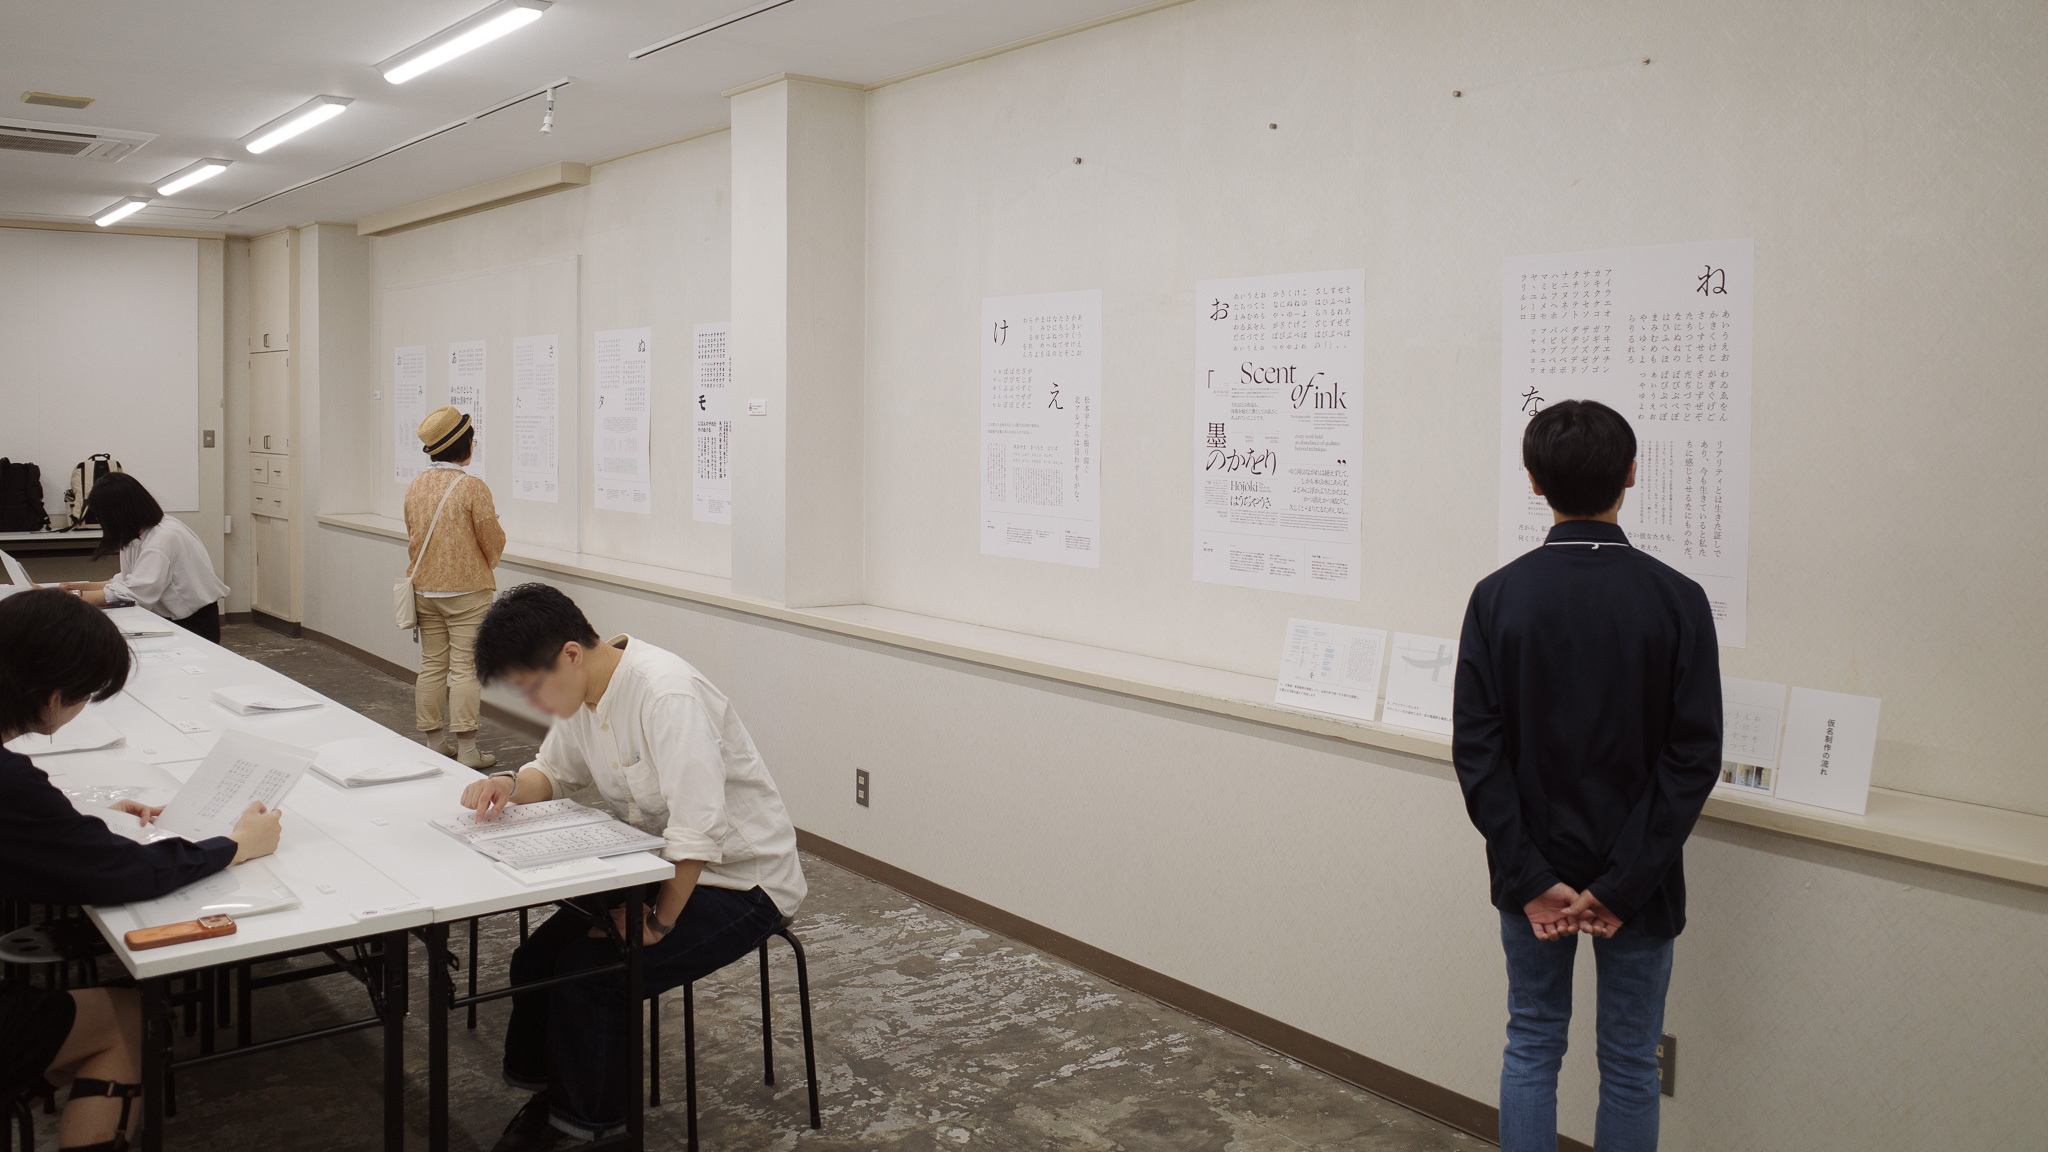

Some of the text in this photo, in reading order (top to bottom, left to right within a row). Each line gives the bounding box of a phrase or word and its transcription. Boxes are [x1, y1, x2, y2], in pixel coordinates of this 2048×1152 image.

[1697, 265, 1727, 296] ね
[1210, 298, 1229, 321] お
[638, 339, 646, 352] ぬ
[994, 320, 1008, 346] け
[548, 345, 554, 358] さ
[1241, 361, 1297, 384] Scent
[598, 395, 604, 409] タ
[698, 395, 706, 411] モ
[1049, 382, 1063, 409] え
[1291, 372, 1325, 409] of
[1314, 382, 1347, 409] ink
[1521, 385, 1545, 417] な
[1206, 422, 1226, 448] 墨
[1206, 448, 1277, 476] のかをり
[1683, 440, 1694, 560] ちに感じさせるなにものかだ。
[1698, 440, 1709, 557] あり、今も生きていると私た
[1714, 440, 1723, 558] リアリティとは生きた証しで
[1820, 719, 1835, 775] 仮名制作の流れ
